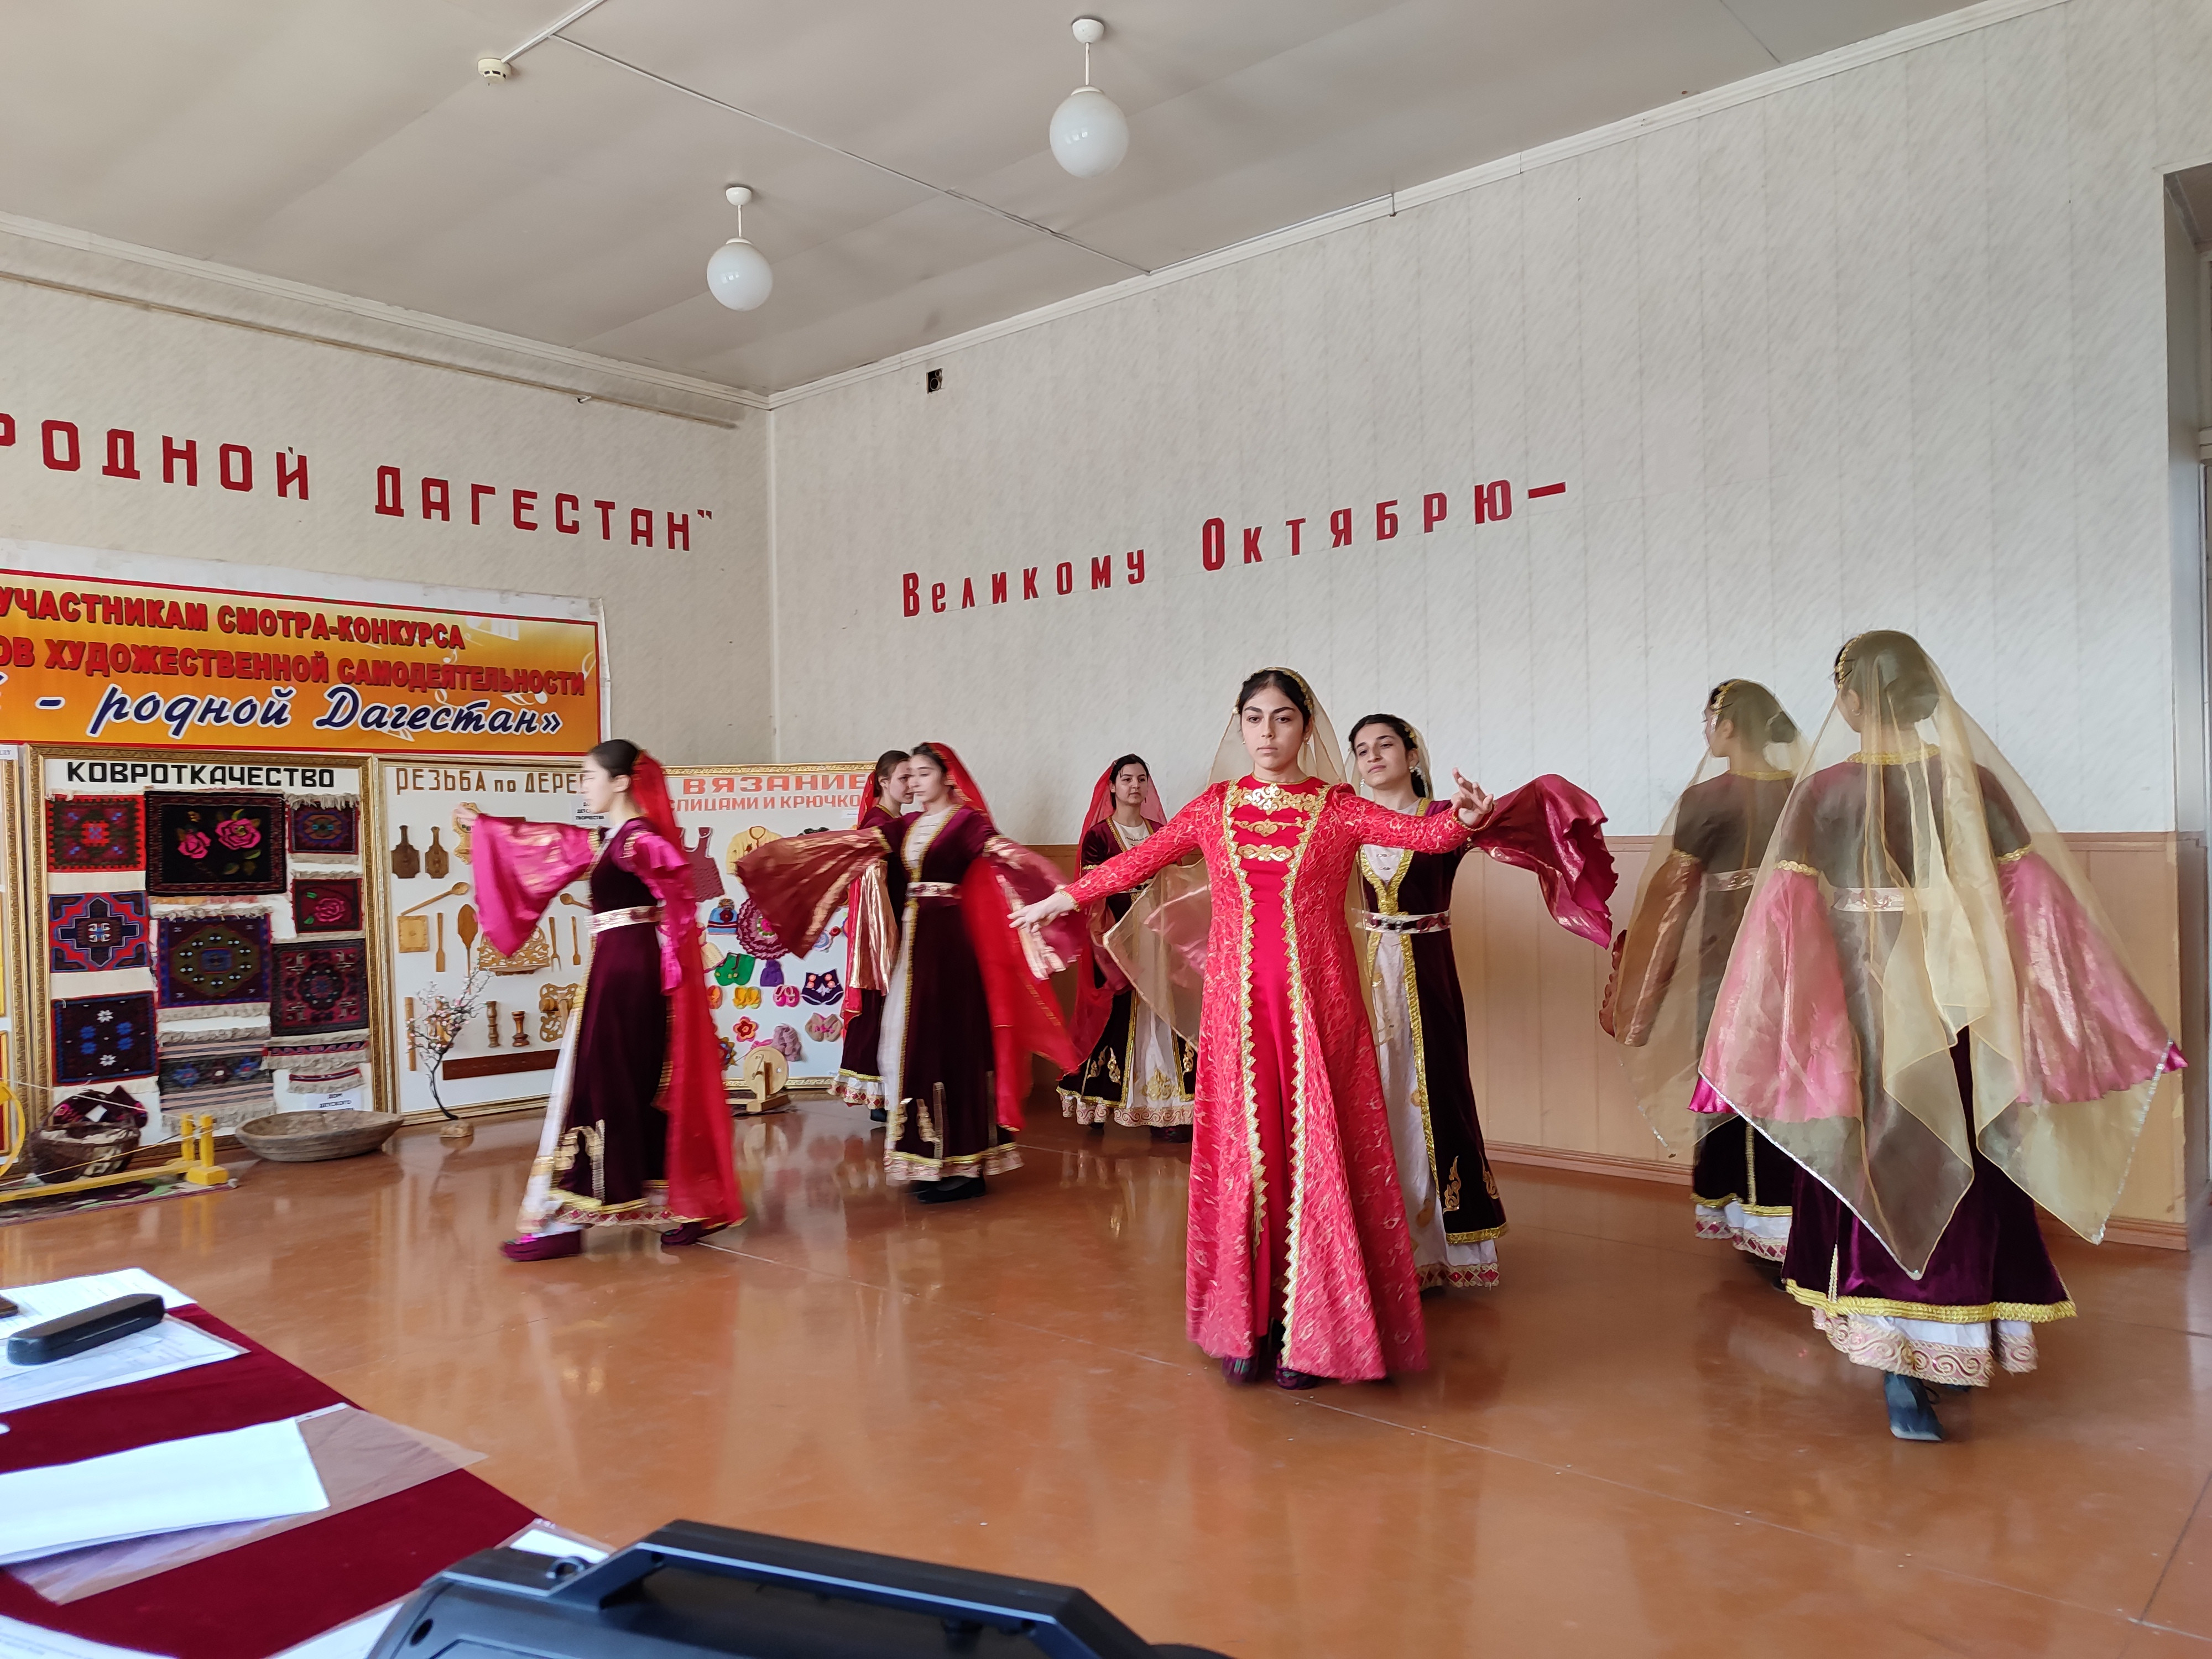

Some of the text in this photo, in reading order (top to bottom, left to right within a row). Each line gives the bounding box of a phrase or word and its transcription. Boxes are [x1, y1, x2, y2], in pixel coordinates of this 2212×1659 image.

[0, 586, 466, 650] УЧАСТНИКАМ СМОТРА-КОНКУРСА
[44, 638, 330, 684] ХУДОЖЕСТВЕННОЙ
[337, 658, 585, 696] САМОДЕЯТЕЛЬНОСТИ
[87, 685, 293, 736] родной
[315, 686, 563, 734] Дагестан»
[67, 761, 335, 787] КОВРОТКАЧЕСТВО
[396, 768, 487, 795] РЕЗЬБА
[494, 779, 517, 792] по
[682, 774, 866, 795] ВЯЗАНИЕ
[763, 796, 775, 810] И
